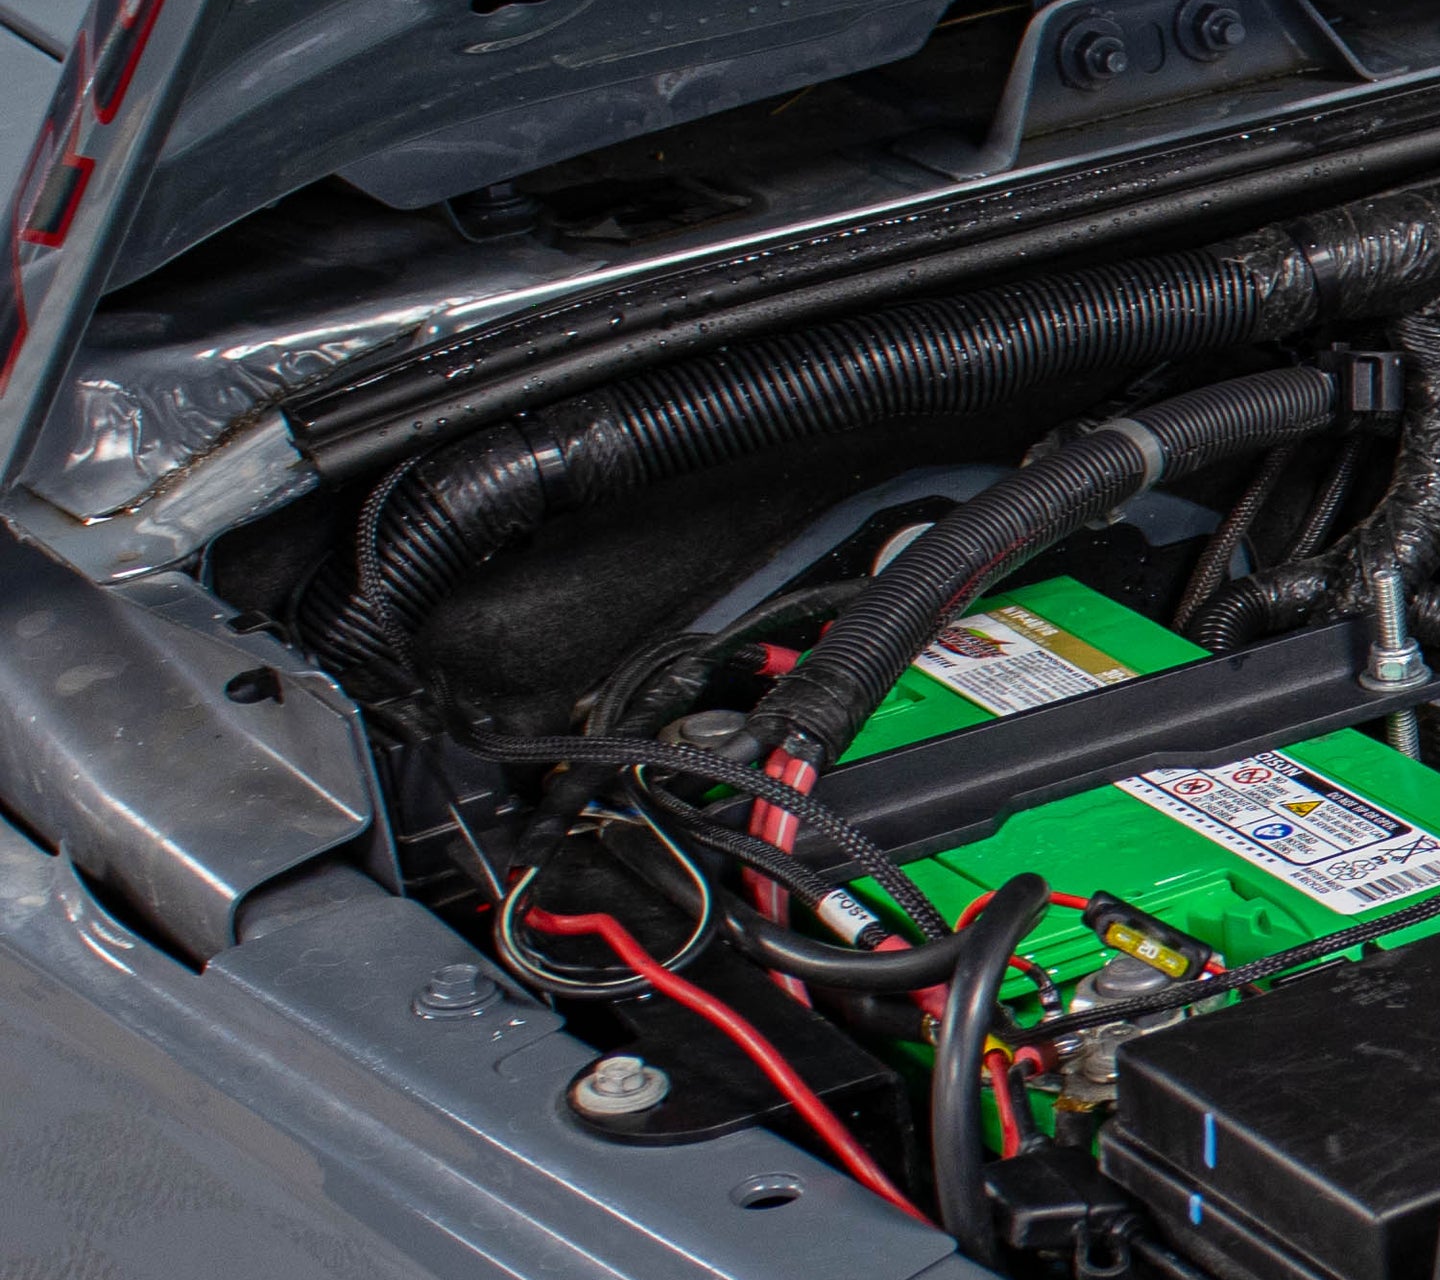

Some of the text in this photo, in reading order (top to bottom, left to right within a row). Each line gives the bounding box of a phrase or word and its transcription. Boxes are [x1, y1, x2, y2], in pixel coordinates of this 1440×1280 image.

[1255, 752, 1304, 778] OISON
[831, 892, 869, 920] POS+
[1136, 939, 1160, 960] 20
